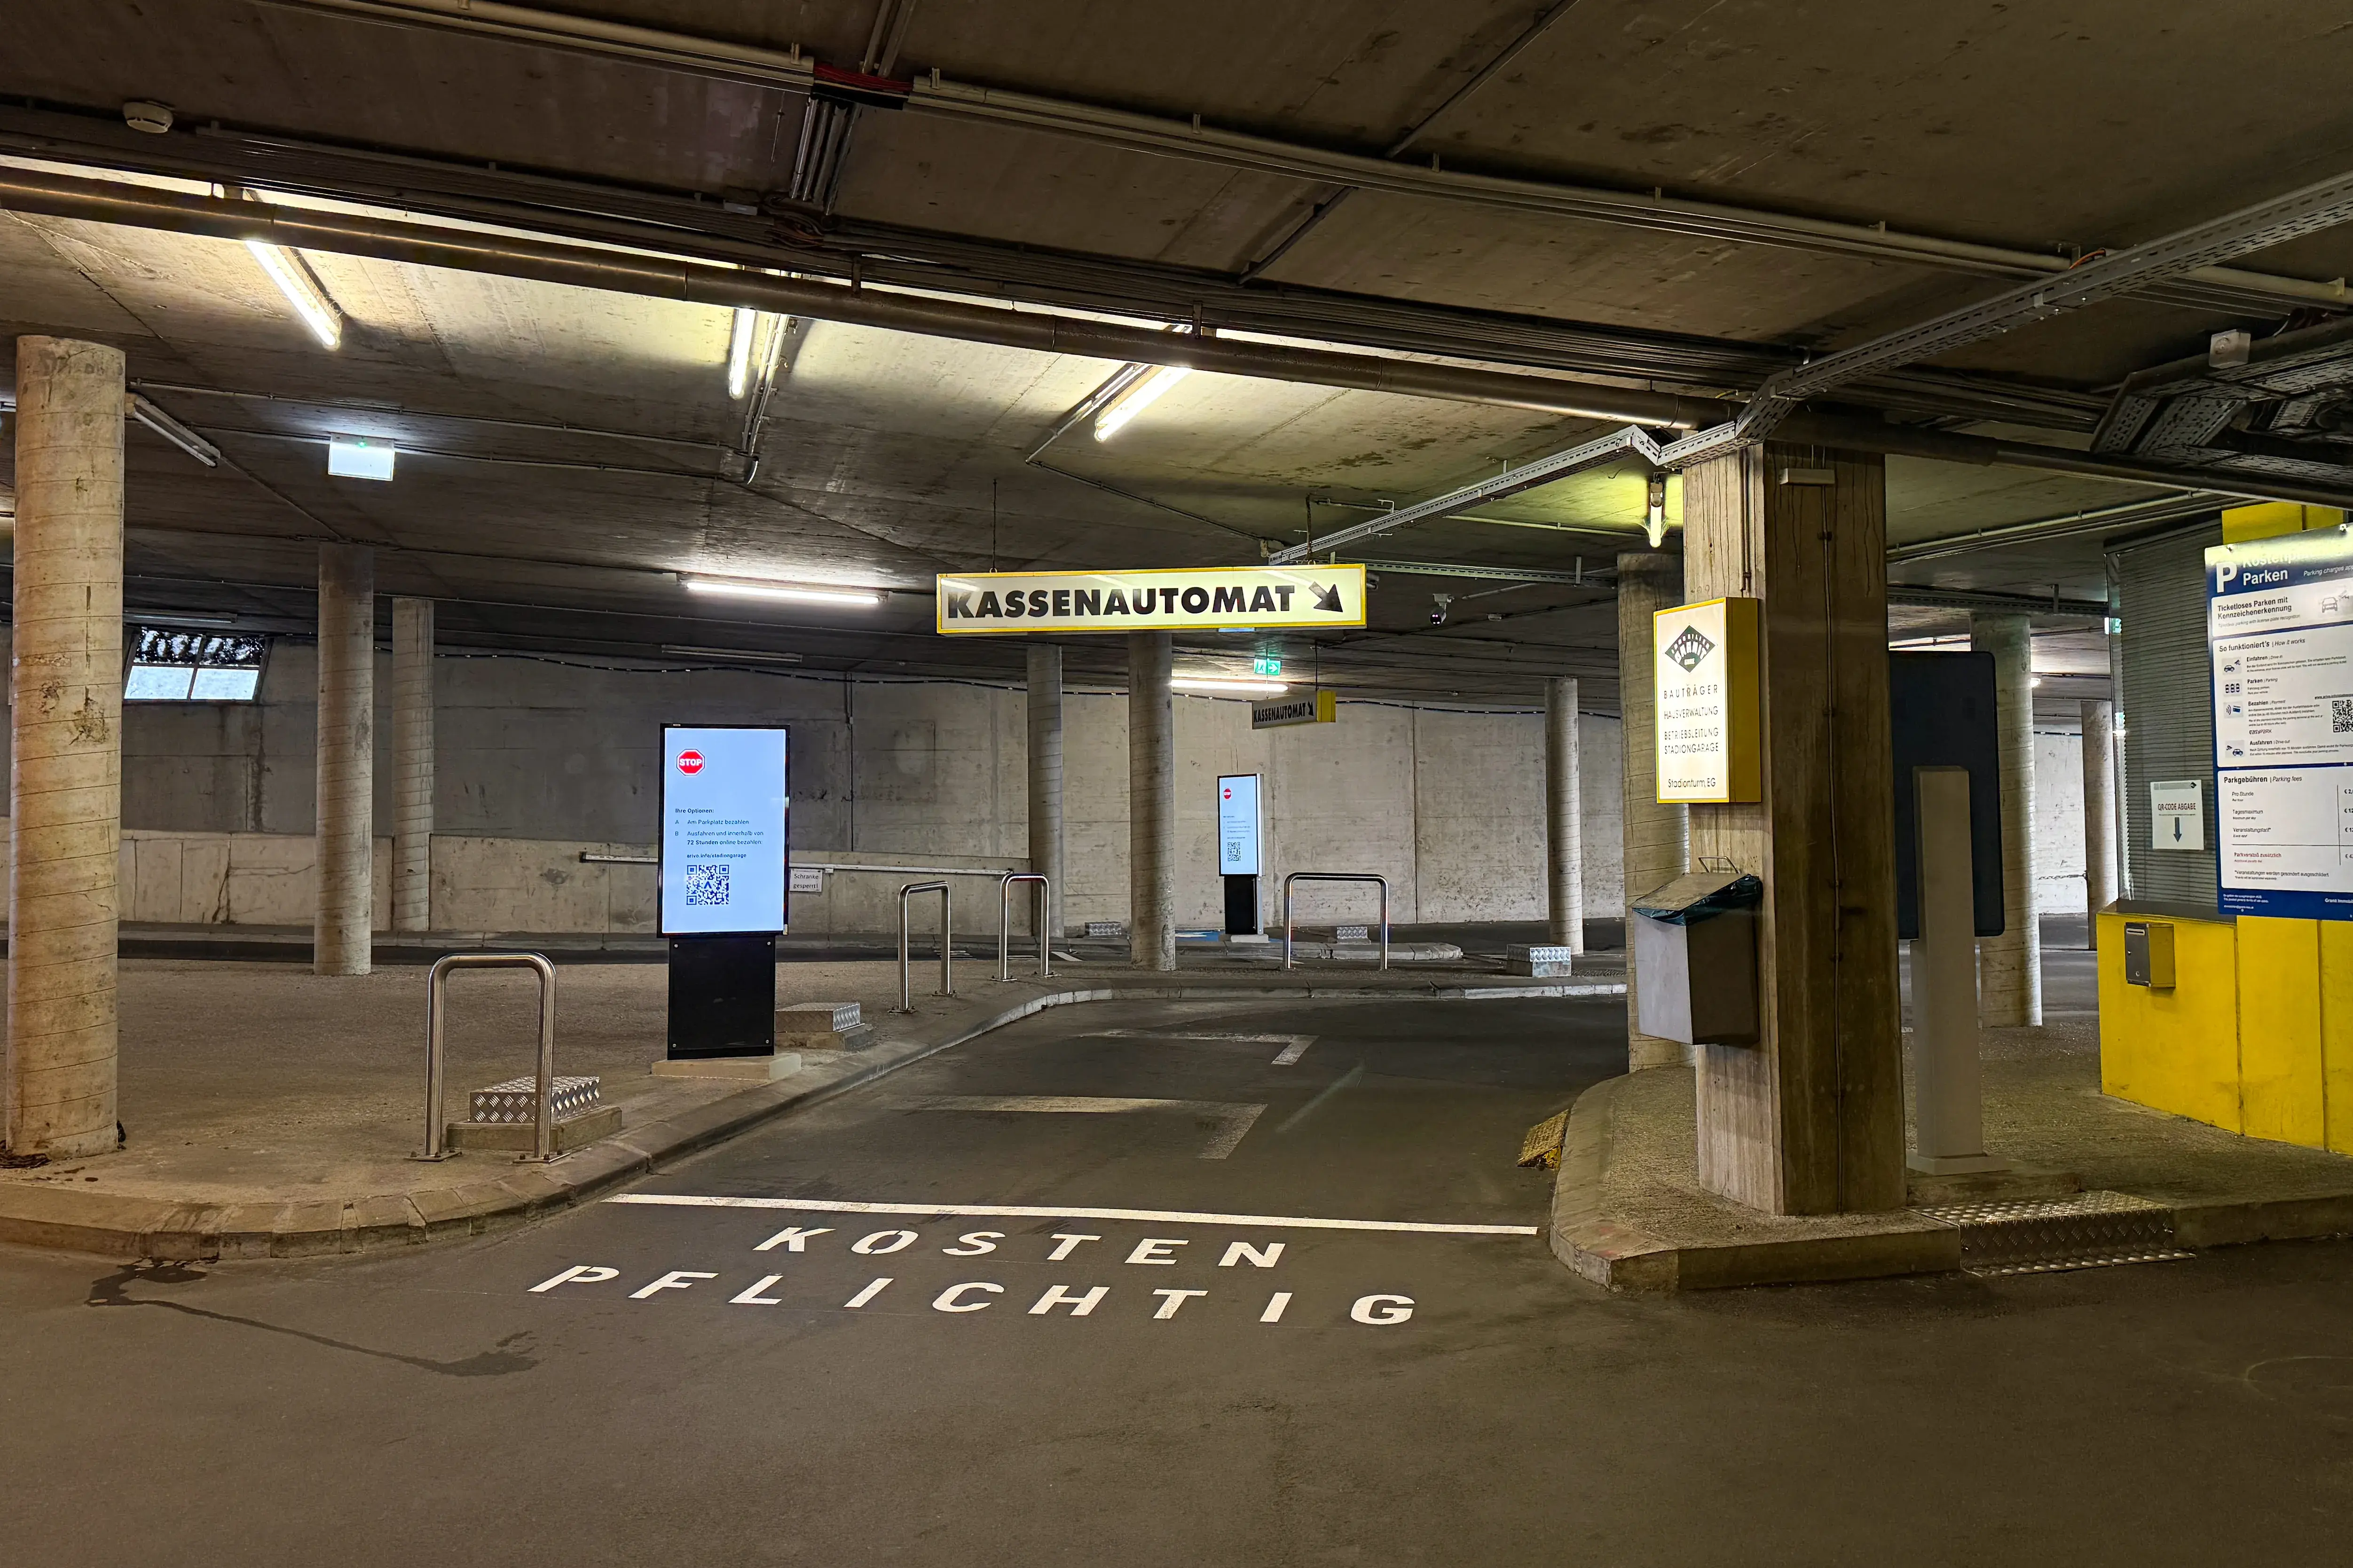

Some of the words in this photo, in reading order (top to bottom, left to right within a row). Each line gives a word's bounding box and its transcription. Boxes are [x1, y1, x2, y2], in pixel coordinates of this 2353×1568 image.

[2216, 561, 2237, 593] P
[2243, 569, 2288, 586] Parken
[947, 585, 1296, 619] KASSENAUTOMAT
[2218, 602, 2252, 612] Ticketloses
[2253, 599, 2276, 608] Parken
[2218, 605, 2292, 620] Kennzeichenerkennung
[2229, 641, 2270, 651] funktioniert's
[1664, 684, 1718, 699] BAUTRÄGER
[1253, 702, 1306, 723] KASSENAUTOMAT
[1664, 706, 1718, 720] HAUSVERWALTUNG
[1665, 727, 1719, 740] BETRIEBSLEITUNG
[1665, 742, 1719, 754] STADIONGARAGE
[679, 758, 702, 767] STOP
[1707, 777, 1716, 787] EG
[2157, 803, 2177, 811] QR-CODE
[751, 1226, 1287, 1268] KOSTEN
[527, 1264, 1417, 1325] PFLICHTIG
